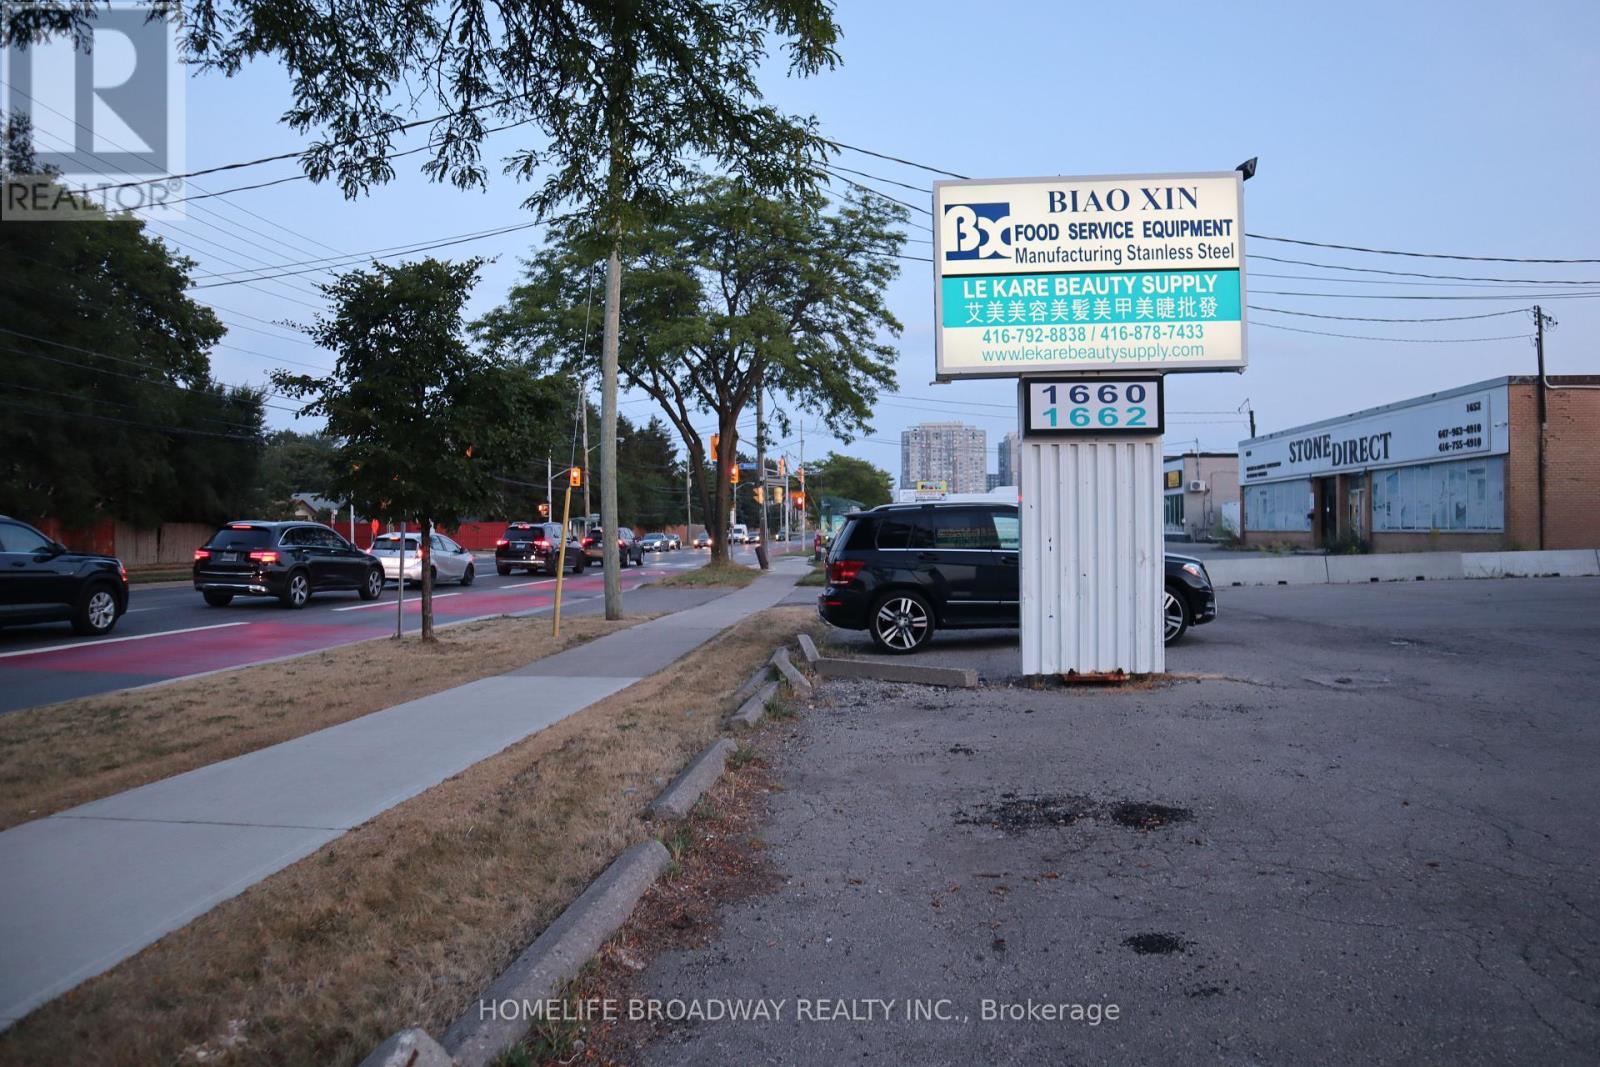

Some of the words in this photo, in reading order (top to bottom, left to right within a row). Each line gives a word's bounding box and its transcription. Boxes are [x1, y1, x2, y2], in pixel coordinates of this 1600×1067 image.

[1048, 187, 1130, 213] BIAO
[1141, 186, 1198, 211] XIN
[1015, 224, 1059, 241] FOOD
[1068, 222, 1134, 240] SERVICE
[1143, 219, 1232, 239] EQUIPMENT
[1015, 246, 1122, 265] Manufacturing
[1198, 242, 1235, 259] Steel
[964, 280, 986, 299] LE
[993, 279, 1049, 297] KARE
[1055, 276, 1136, 296] BEAUTY
[1142, 274, 1217, 293] SUPPLY
[982, 326, 1086, 344] 416-792-8838
[1091, 326, 1096, 341] /
[1101, 324, 1204, 341] 416-878-7433
[982, 343, 1204, 363] www.lekarebeautysupply.com
[1042, 384, 1145, 404] 1660
[1043, 407, 1146, 426] 1662
[1289, 435, 1331, 463] STONE
[1332, 432, 1391, 466] DIRECT
